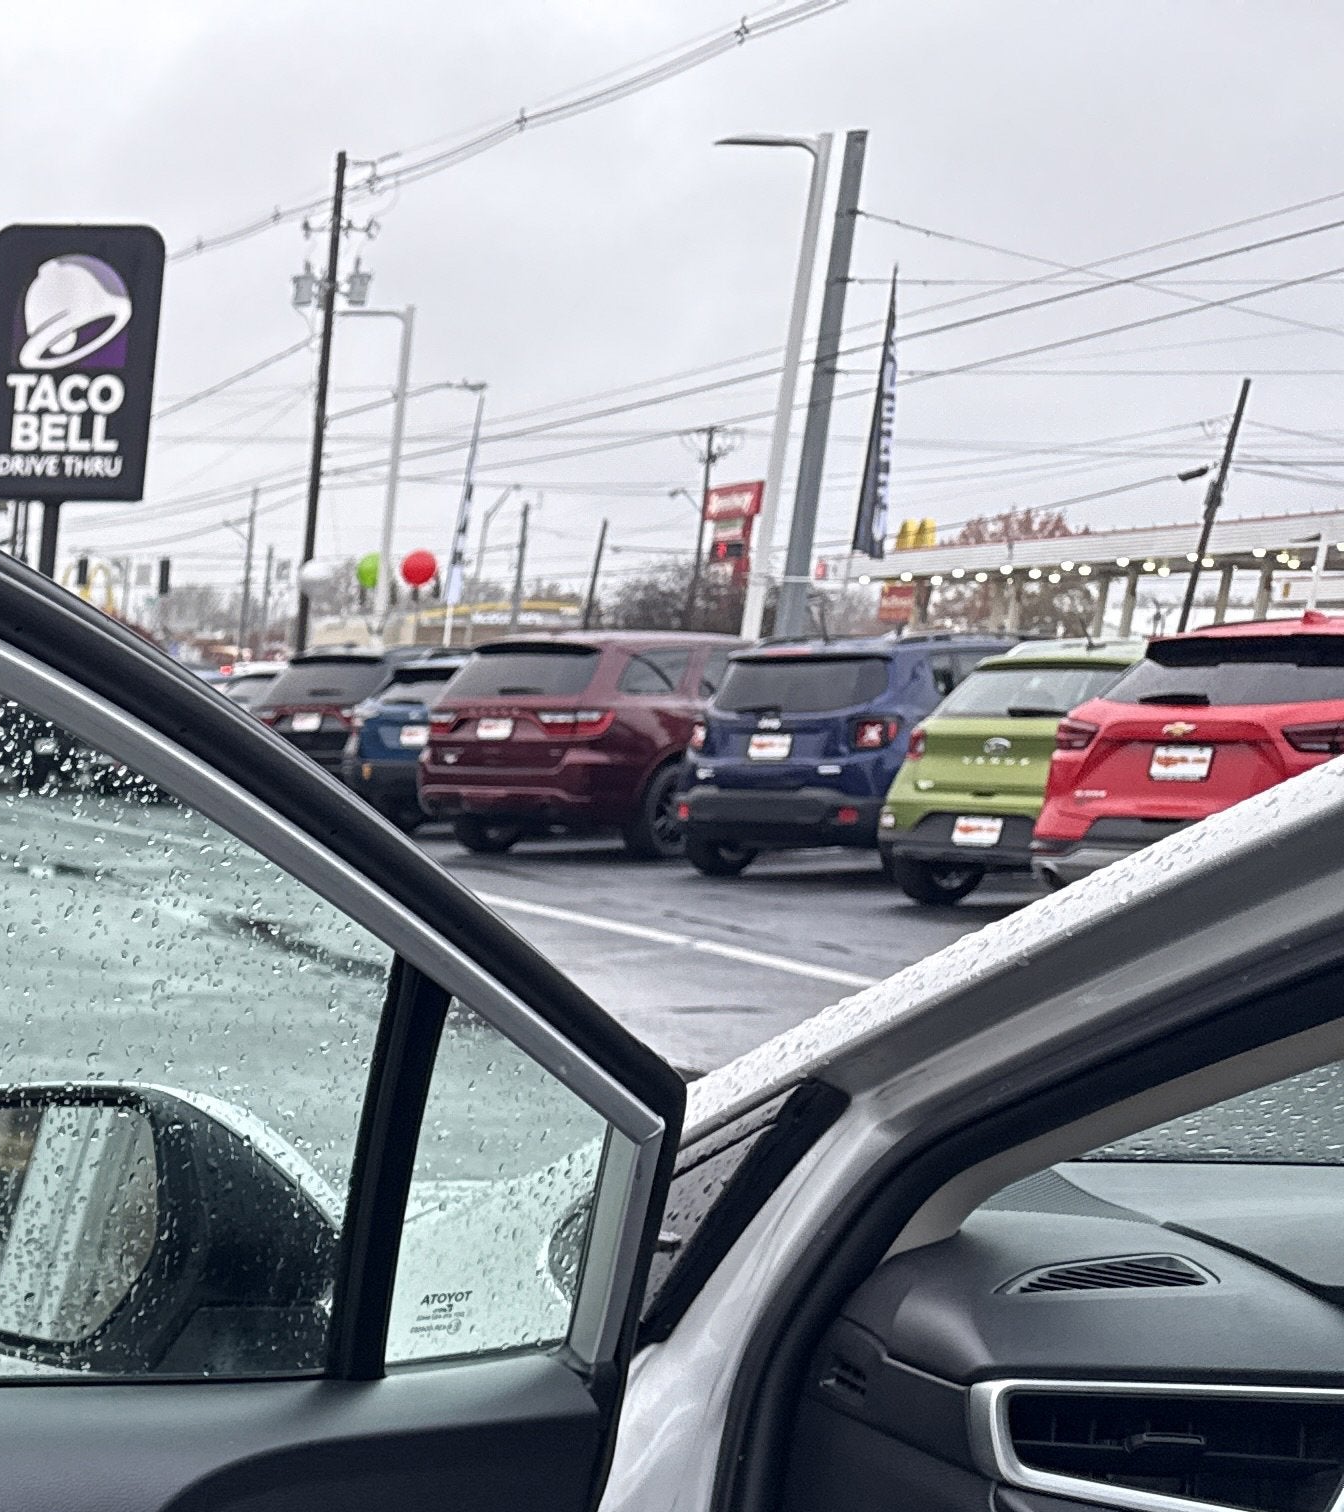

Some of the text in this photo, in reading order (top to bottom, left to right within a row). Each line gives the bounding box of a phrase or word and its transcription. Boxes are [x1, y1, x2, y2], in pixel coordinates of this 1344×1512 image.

[6, 373, 125, 414] TACO
[10, 412, 119, 452] BELL
[62, 454, 123, 478] THRU
